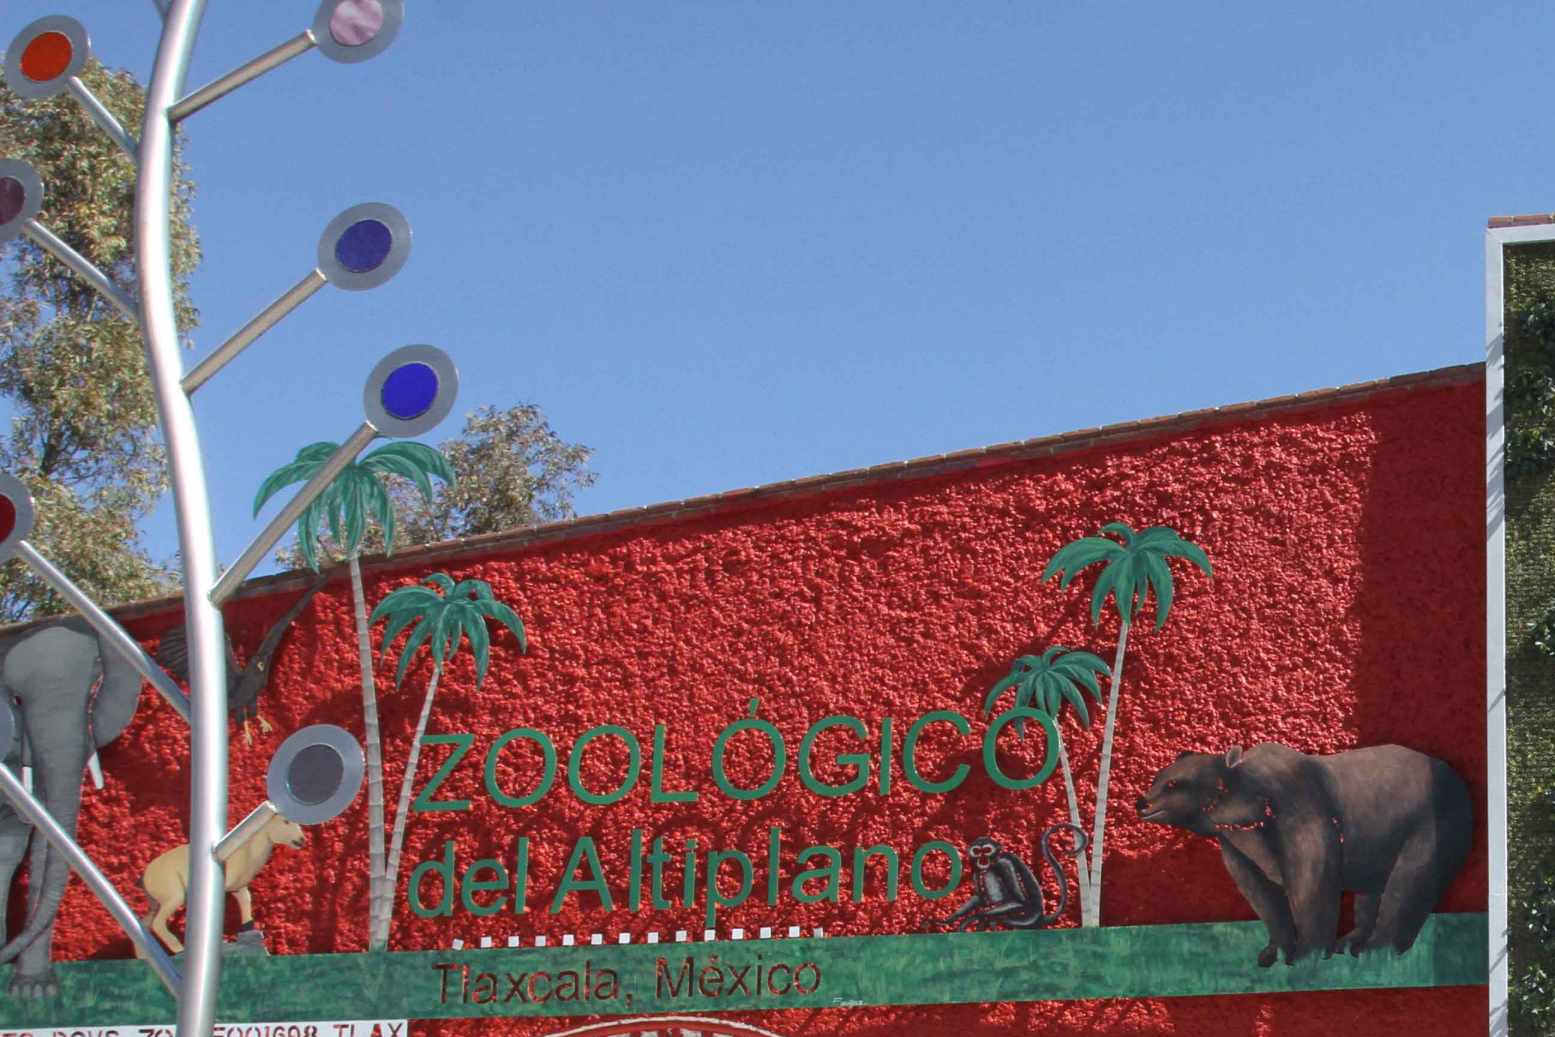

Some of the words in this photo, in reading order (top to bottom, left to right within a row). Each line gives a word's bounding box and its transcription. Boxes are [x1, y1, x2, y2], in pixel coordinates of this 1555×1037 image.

[413, 698, 1063, 811] ZOOLÓGICO
[409, 837, 529, 918] del
[551, 827, 963, 927] Altiplano
[432, 960, 634, 1008] Tlaxcala,
[655, 954, 822, 1000] México
